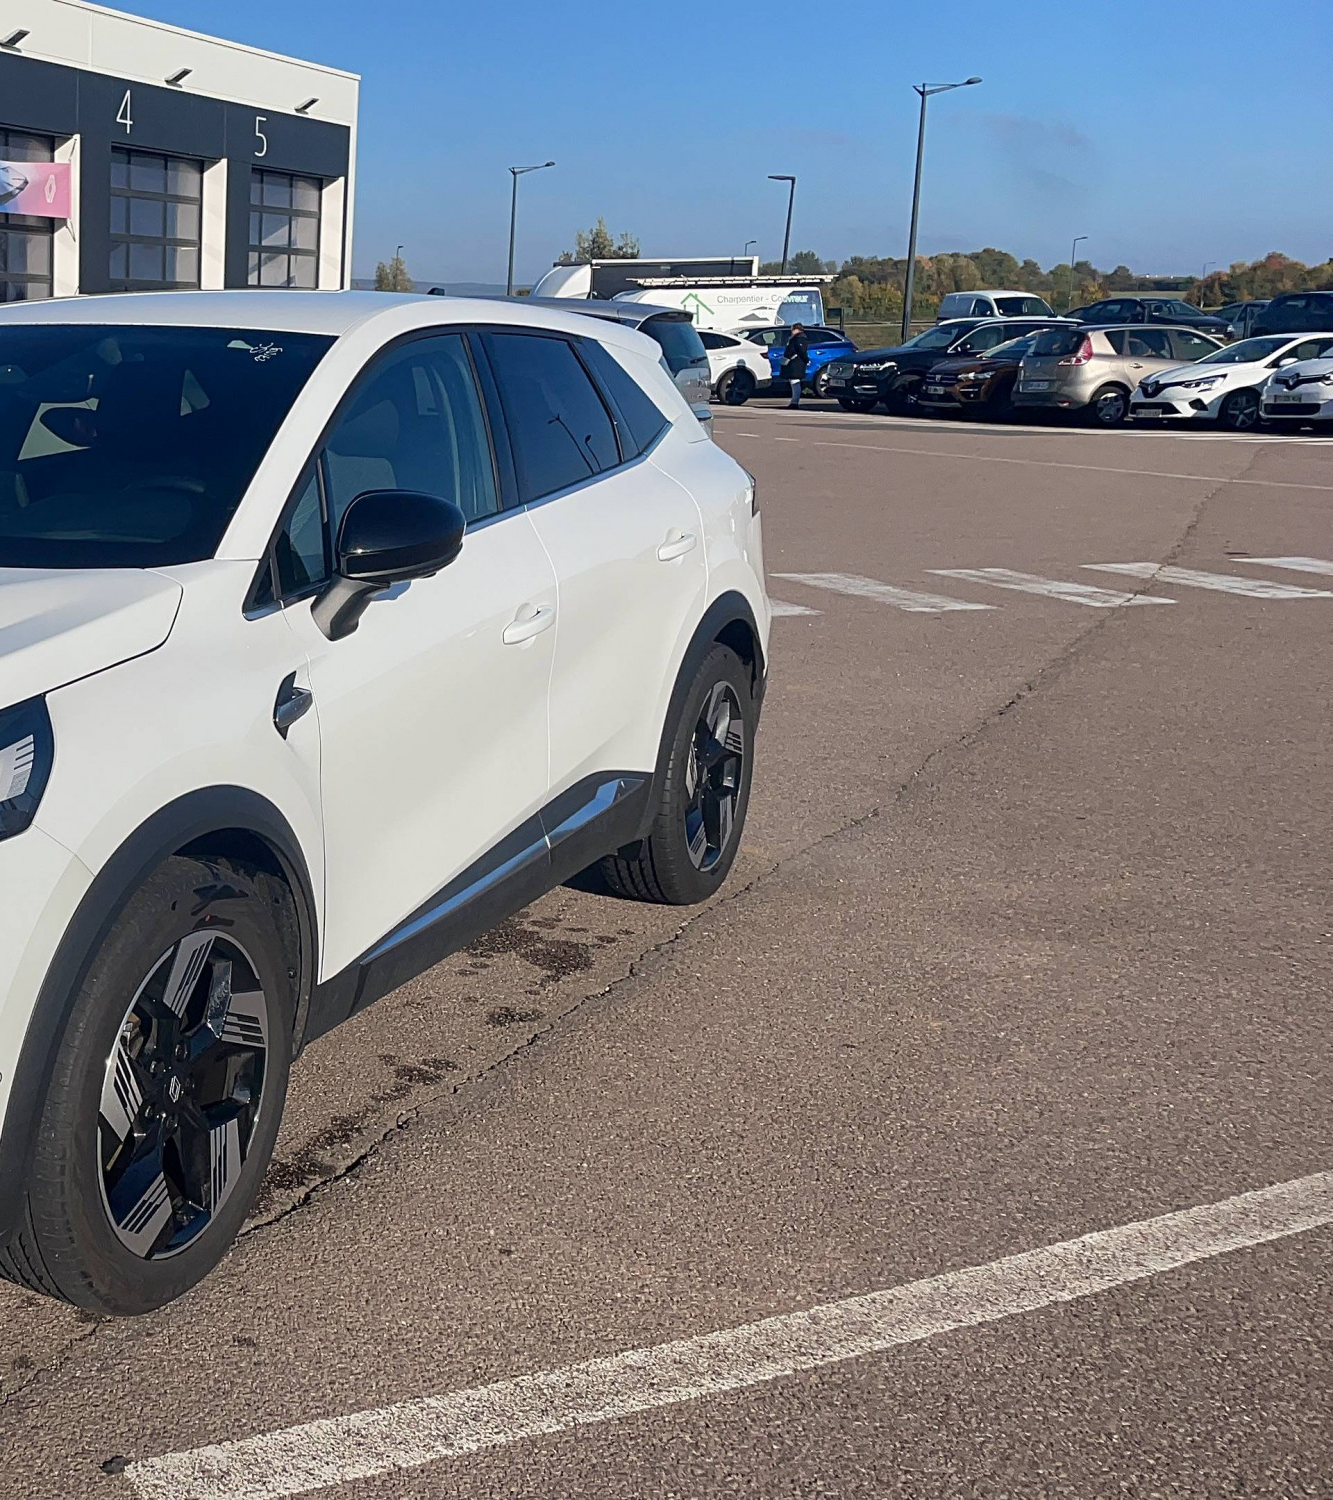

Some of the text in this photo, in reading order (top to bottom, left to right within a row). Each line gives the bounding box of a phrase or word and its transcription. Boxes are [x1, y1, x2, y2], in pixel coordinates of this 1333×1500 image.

[116, 89, 134, 134] 4
[254, 116, 267, 157] 5
[716, 295, 764, 304] Charpentier
